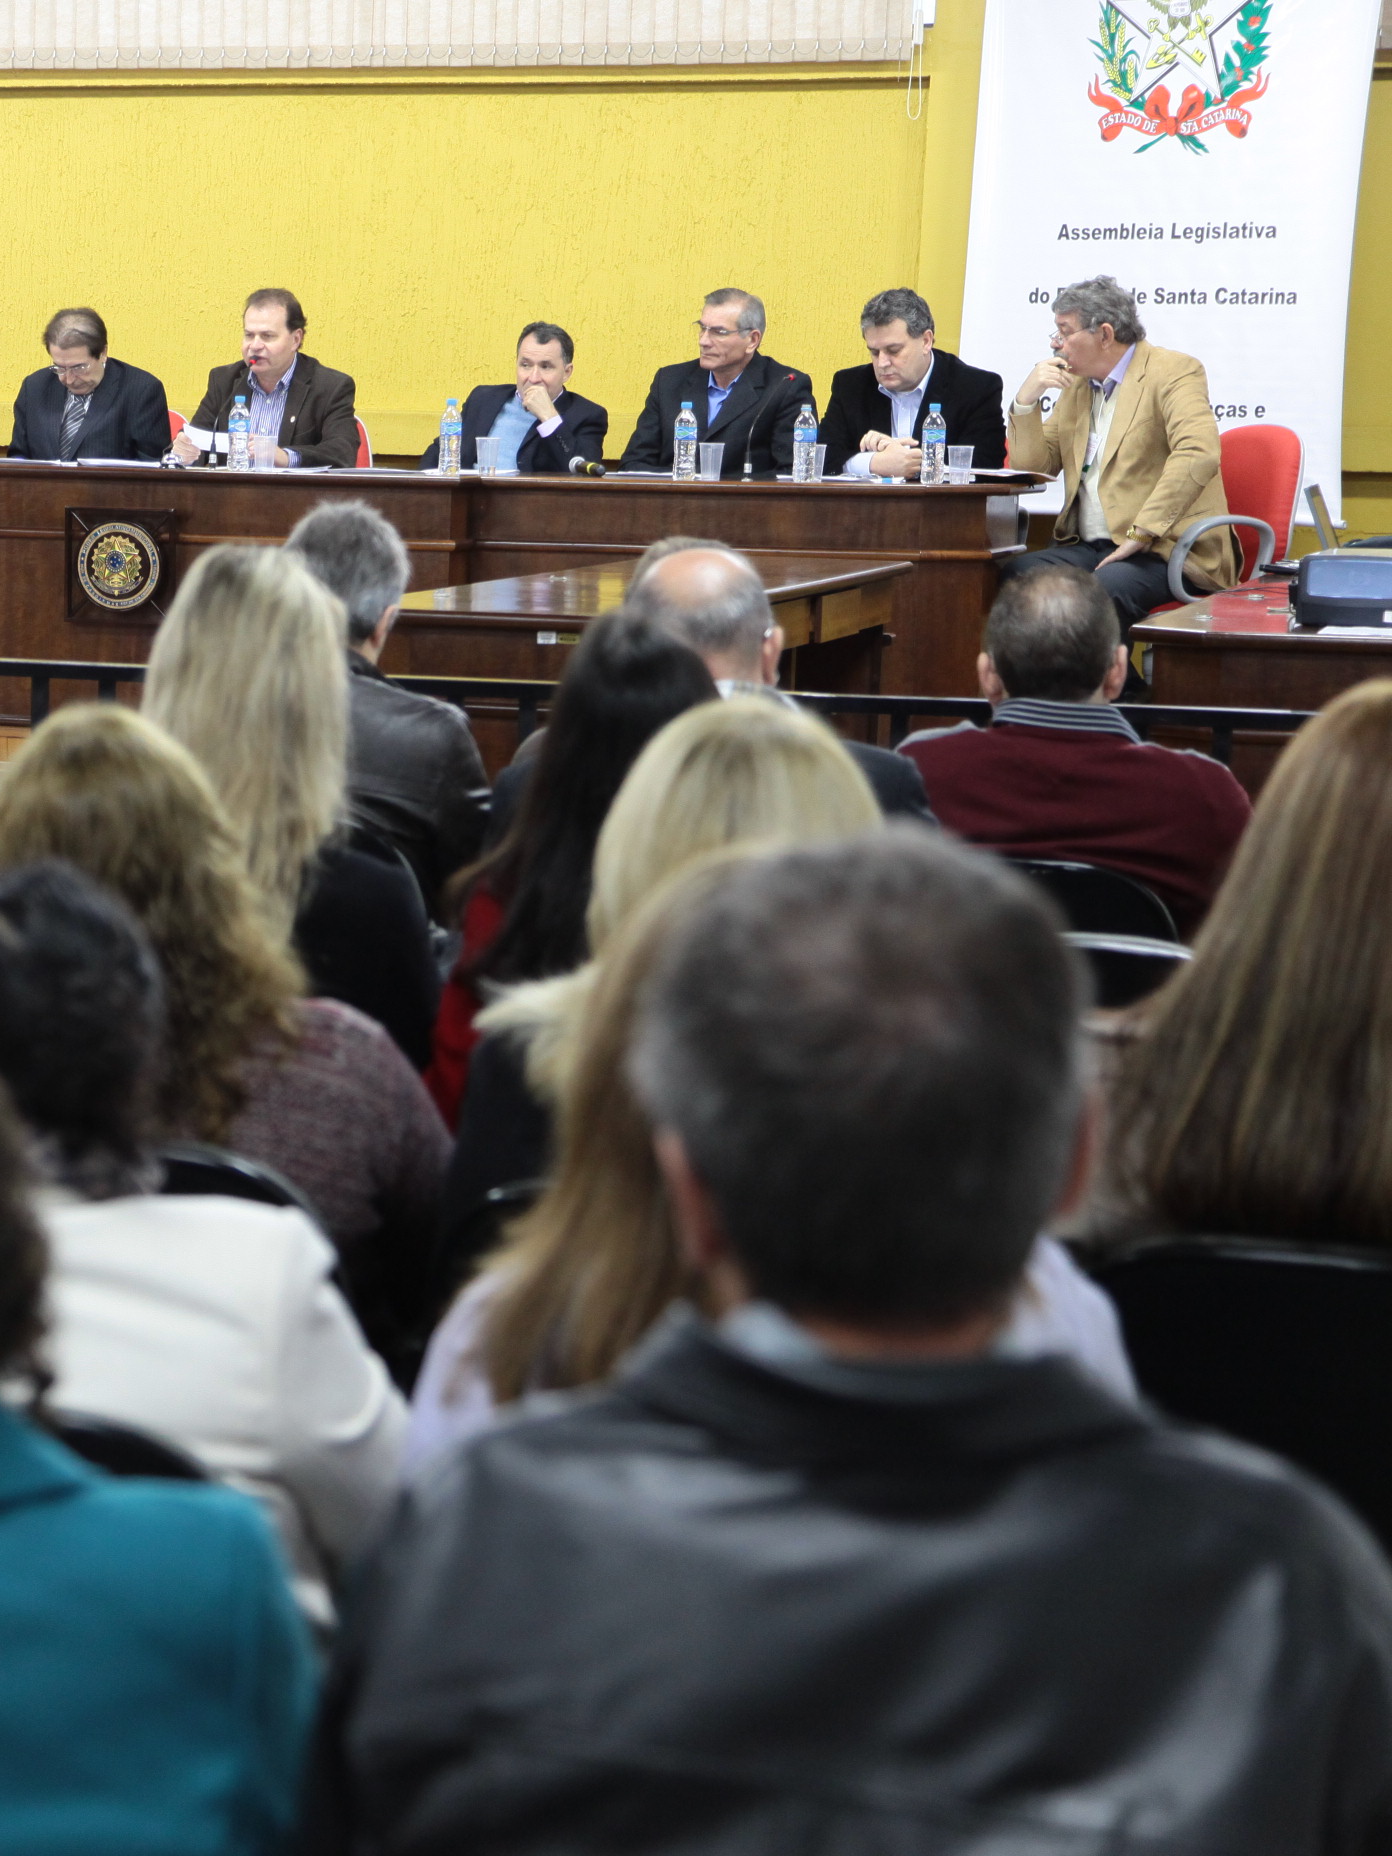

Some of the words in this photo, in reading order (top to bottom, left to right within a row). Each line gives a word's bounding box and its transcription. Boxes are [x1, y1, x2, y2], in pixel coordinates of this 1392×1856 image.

[1101, 113, 1142, 129] ESTADO
[1142, 120, 1158, 133] DE
[1201, 108, 1249, 130] CATARINA
[1057, 221, 1165, 241] Assembleia
[1171, 221, 1277, 244] Legislativa
[1029, 287, 1050, 304] do
[1154, 287, 1207, 304] Santa
[1215, 287, 1298, 304] Catarina
[1254, 406, 1266, 418] e
